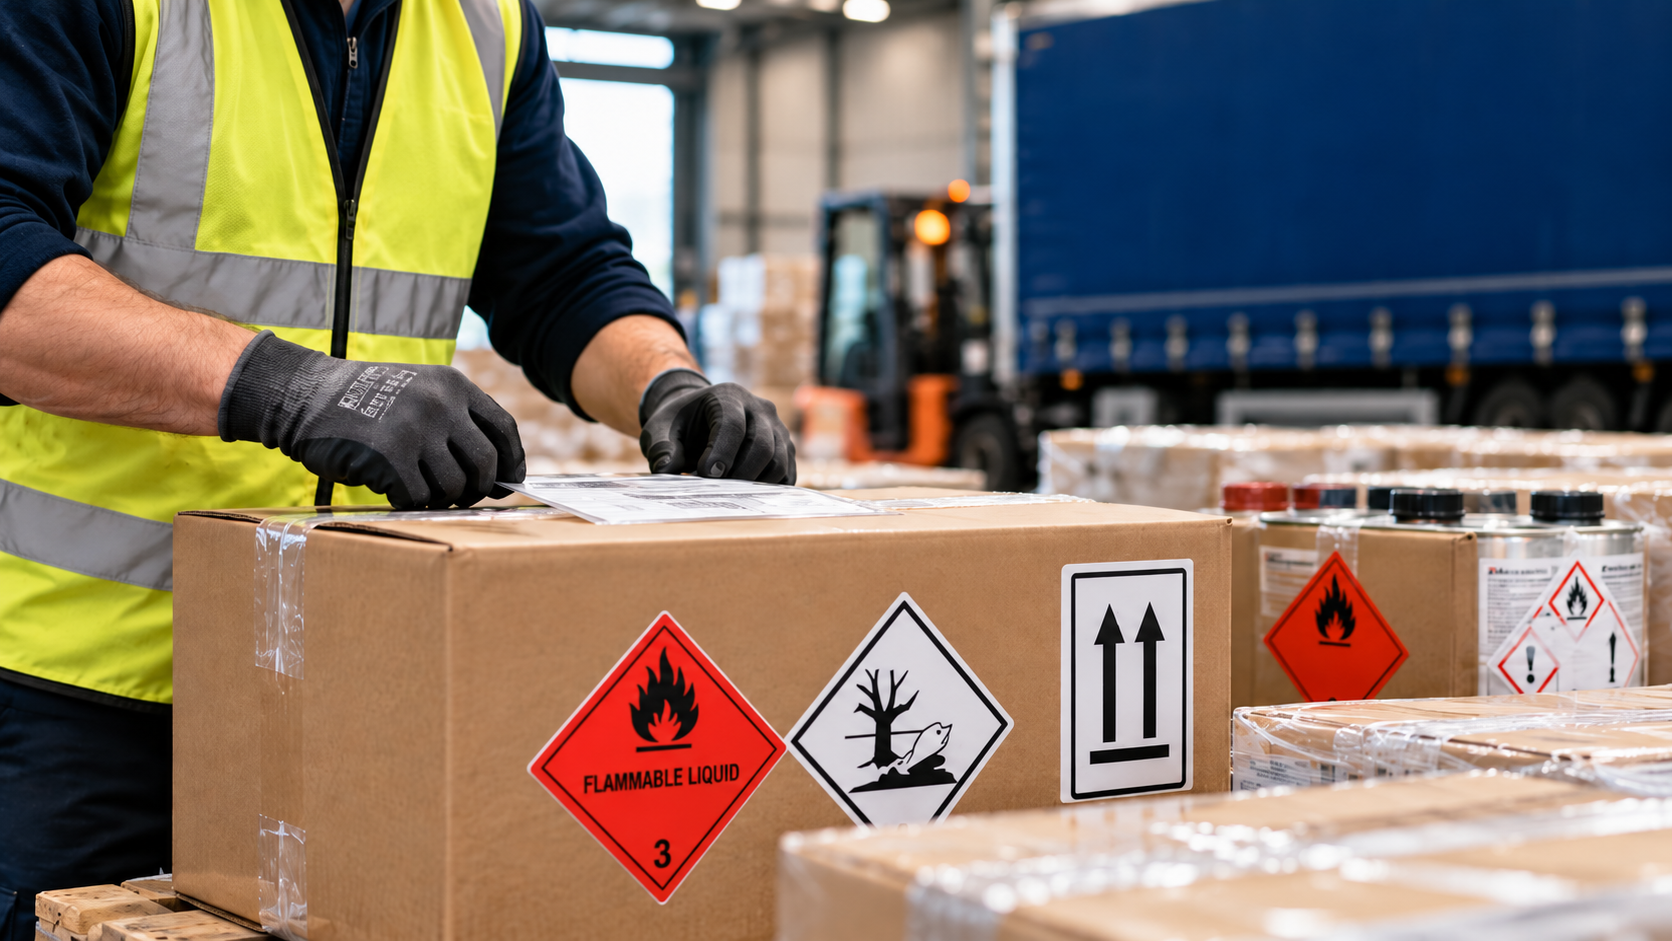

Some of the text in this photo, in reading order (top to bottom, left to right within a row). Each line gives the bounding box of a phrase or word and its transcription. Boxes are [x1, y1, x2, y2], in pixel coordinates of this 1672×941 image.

[584, 763, 740, 794] FLAMMABLE LIQUID
[653, 839, 672, 869] 3
